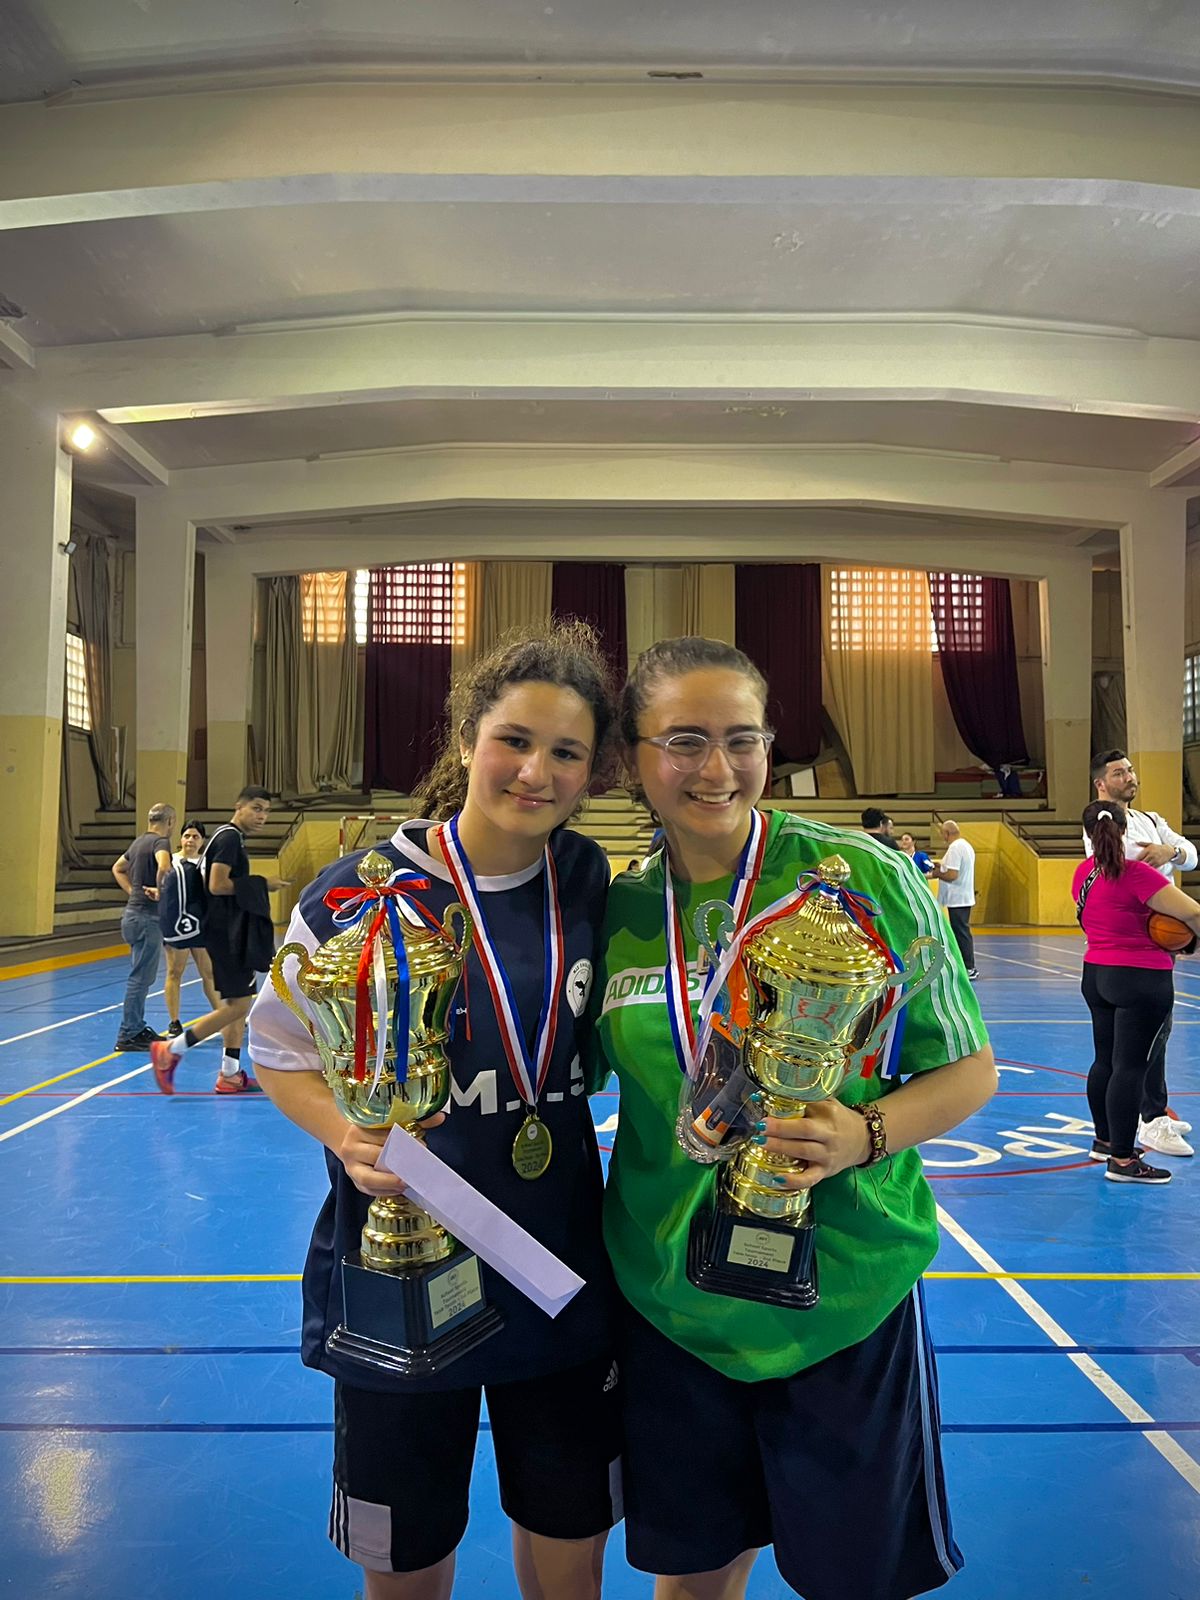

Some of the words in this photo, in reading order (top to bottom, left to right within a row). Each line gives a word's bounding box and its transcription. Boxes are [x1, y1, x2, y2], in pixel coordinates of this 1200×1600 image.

[181, 918, 192, 932] 3
[606, 969, 700, 1004] ADIDS
[747, 1258, 769, 1267] 2024
[448, 1300, 466, 1317] 2024
